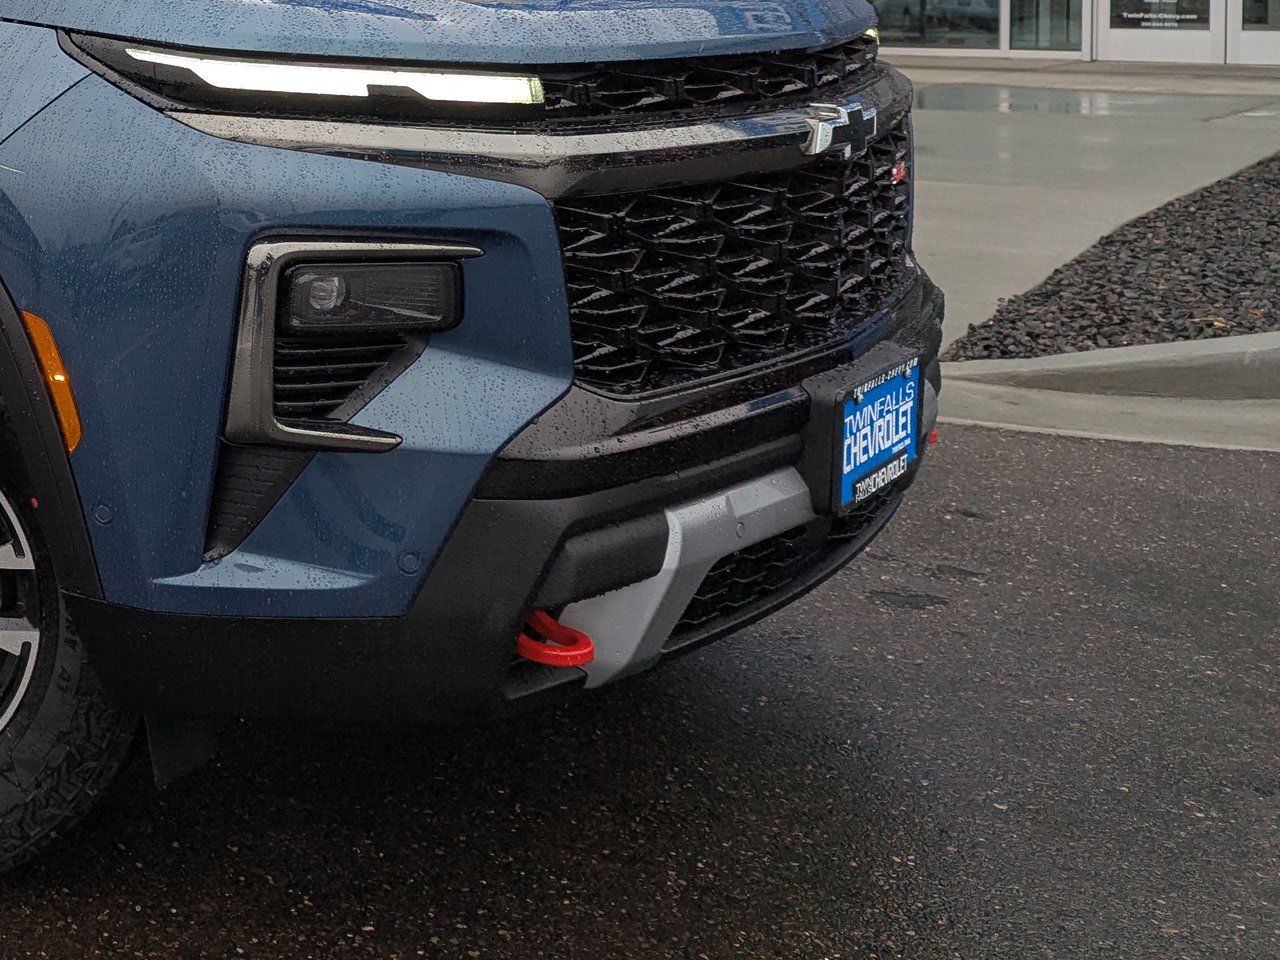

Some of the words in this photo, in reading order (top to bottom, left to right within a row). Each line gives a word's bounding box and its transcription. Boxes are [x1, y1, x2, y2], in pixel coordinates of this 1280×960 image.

[844, 400, 913, 474] CHEVROLET
[845, 381, 915, 437] TWINFALLS
[871, 454, 908, 492] CHEVROLET
